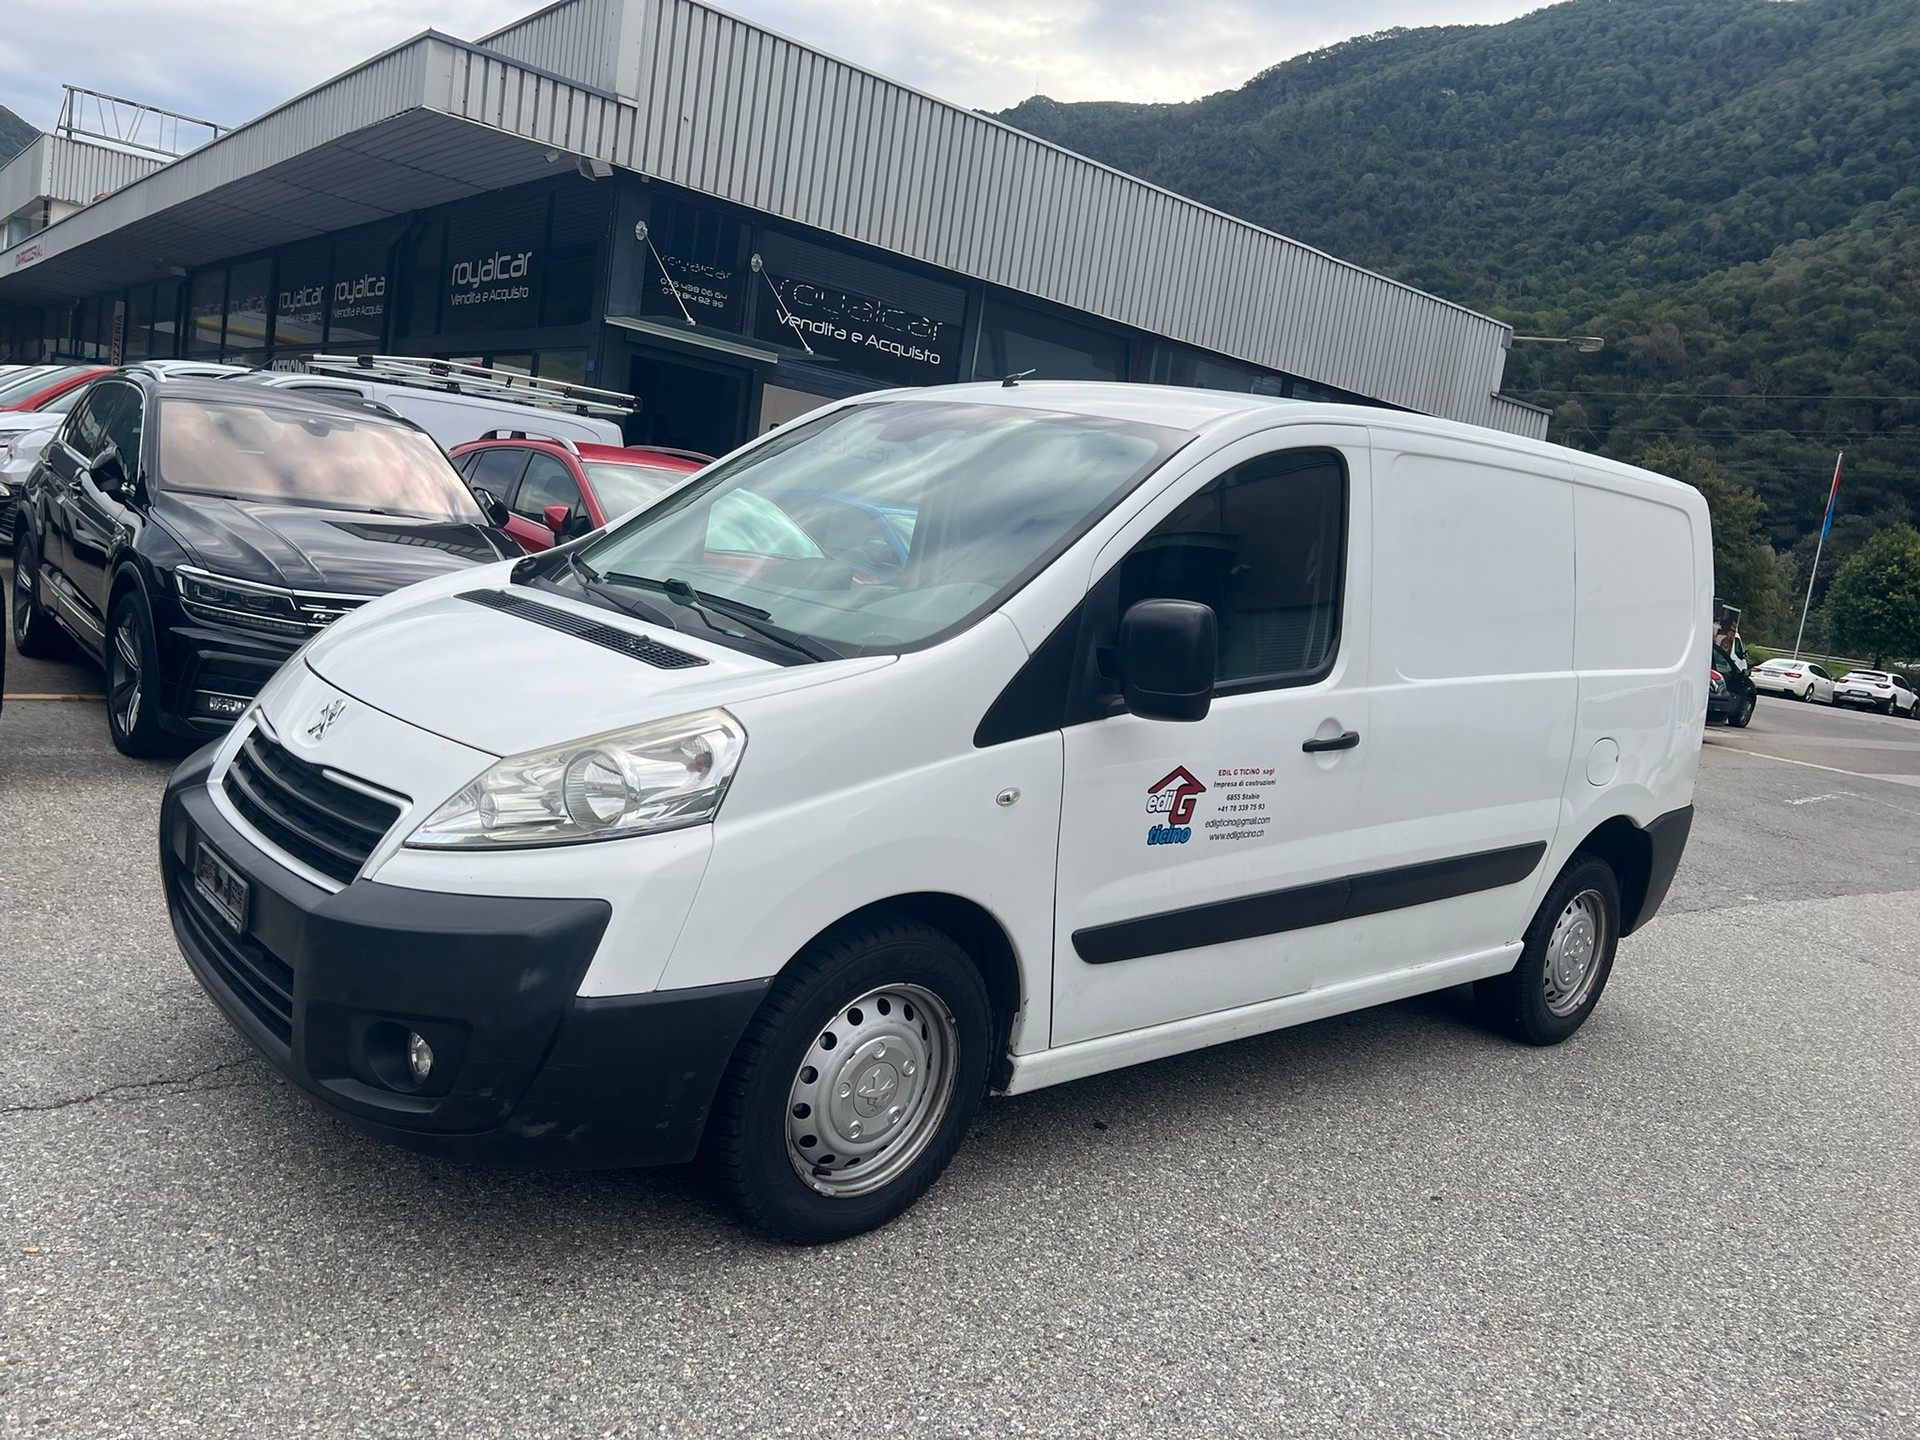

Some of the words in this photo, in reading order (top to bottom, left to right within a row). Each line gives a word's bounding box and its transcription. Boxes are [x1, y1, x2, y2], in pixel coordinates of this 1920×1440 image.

[451, 251, 532, 288] royalcar
[279, 285, 324, 312] royalcar
[334, 273, 385, 304] royalca
[450, 292, 481, 305] Vendita
[482, 291, 489, 302] e
[489, 285, 529, 302] Acquisto
[361, 304, 384, 316] Acquis
[780, 279, 943, 341] royalcar
[113, 314, 122, 366] OZZERIA
[776, 309, 847, 340] Vendita
[851, 331, 863, 343] e
[865, 335, 941, 365] Acquisto
[1239, 768, 1261, 776] TICINO
[1213, 781, 1237, 789] Impresa
[1238, 779, 1244, 787] di
[1226, 793, 1241, 801] 6855
[1242, 792, 1260, 800] Stabio
[1204, 816, 1271, 829] edilgticino@gmail.com
[1147, 824, 1191, 845] ticino
[1209, 829, 1264, 840] www.edilgticino.ch
